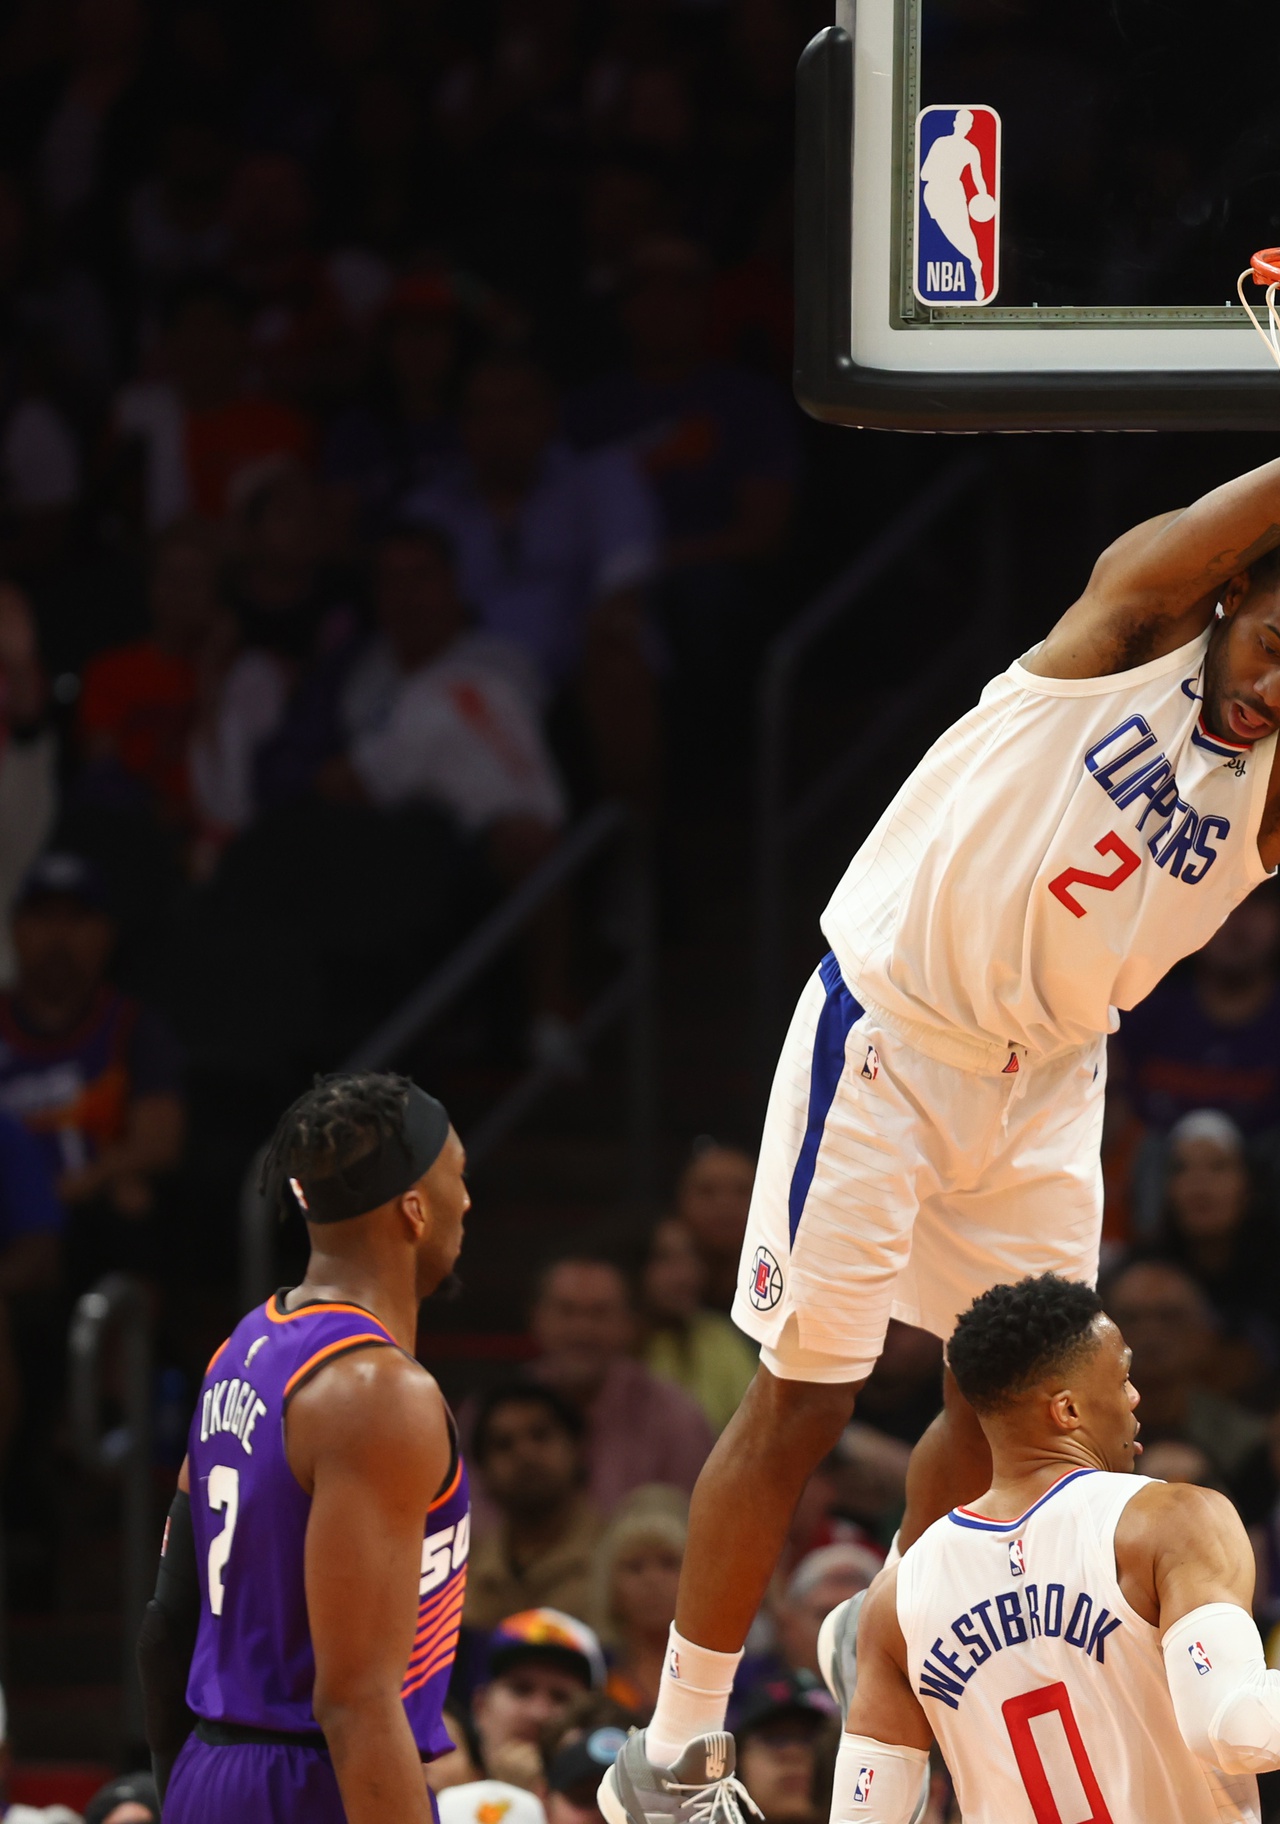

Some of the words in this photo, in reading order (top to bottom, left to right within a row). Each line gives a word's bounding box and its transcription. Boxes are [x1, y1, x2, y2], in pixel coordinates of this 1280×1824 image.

[926, 261, 966, 292] NBA
[1084, 713, 1231, 885] CLIPPERS
[1047, 829, 1142, 918] 2
[200, 1377, 269, 1456] OKOGIE
[207, 1464, 240, 1618] 2
[919, 1582, 1123, 1711] WESTBROOK
[1001, 1680, 1116, 1824] 0
